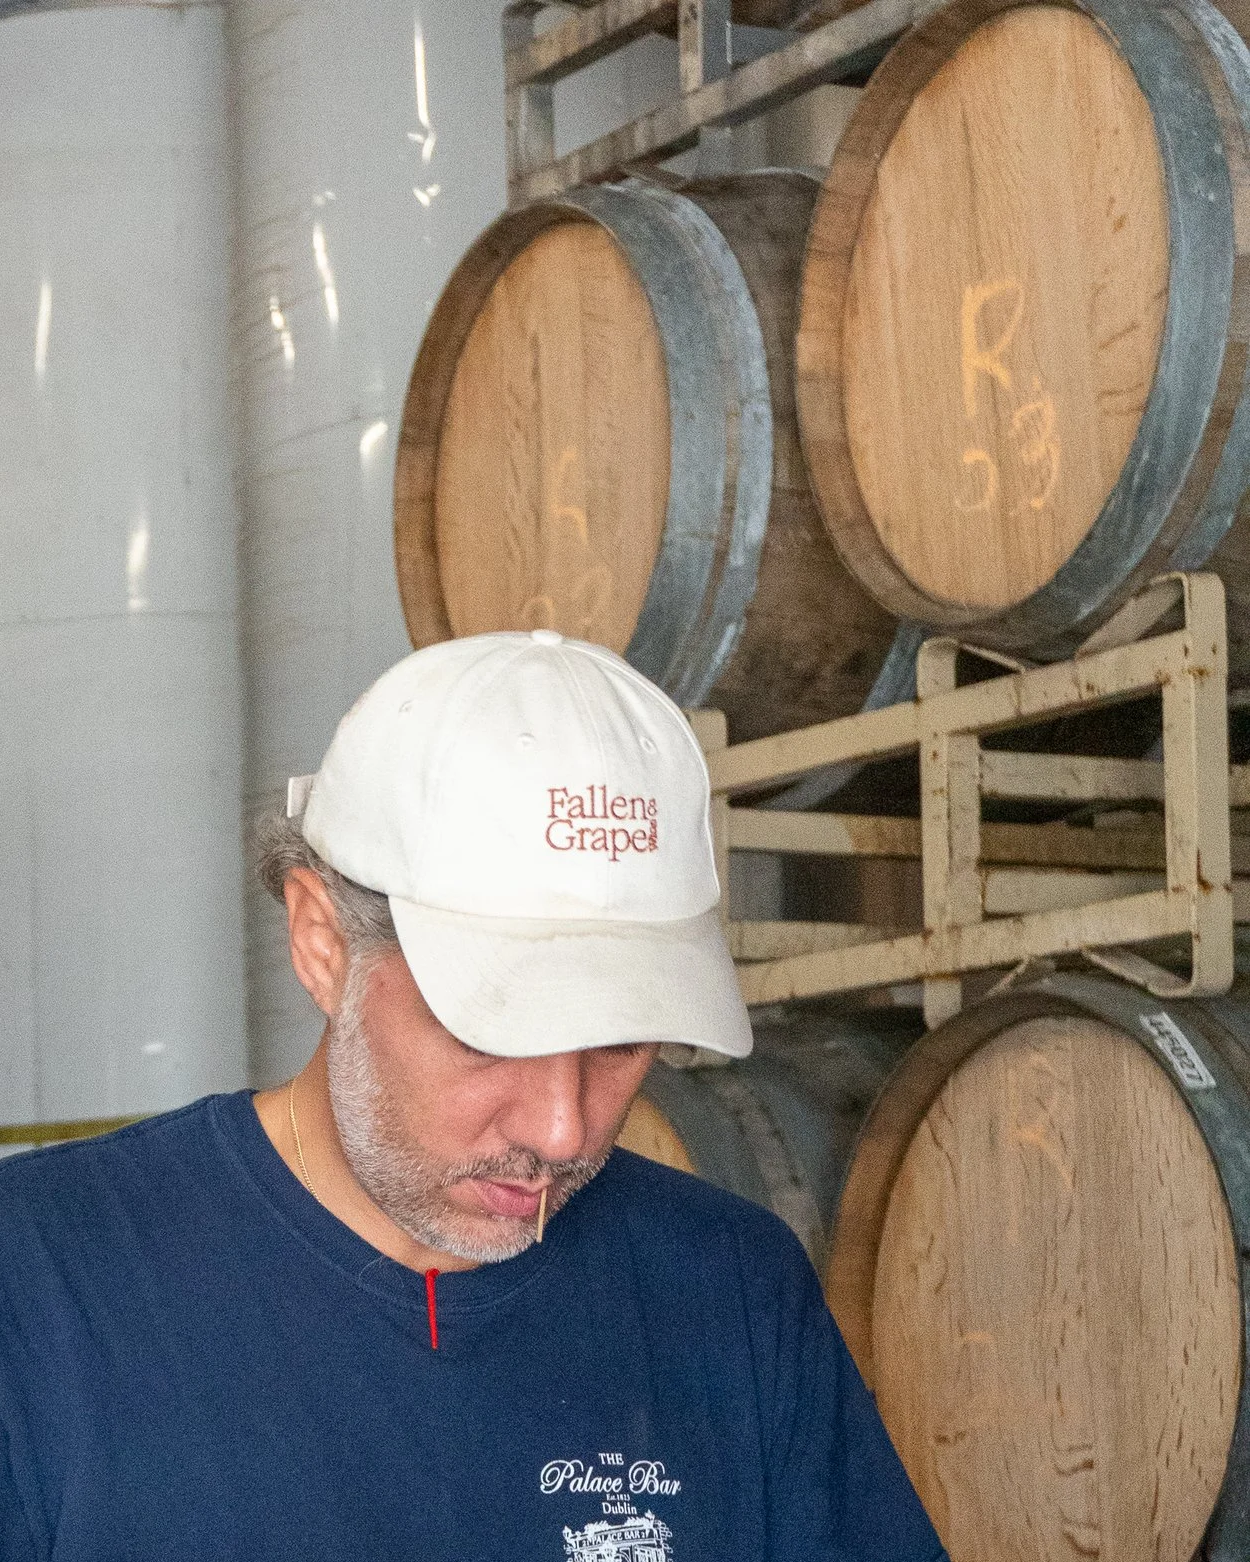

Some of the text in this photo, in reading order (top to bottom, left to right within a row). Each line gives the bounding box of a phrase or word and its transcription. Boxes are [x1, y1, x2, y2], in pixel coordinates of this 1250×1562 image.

[546, 784, 649, 820] Fallen
[545, 819, 651, 862] Grape
[539, 1459, 682, 1496] Palace Bar
[598, 1453, 625, 1466] THE
[601, 1502, 638, 1516] Dublin
